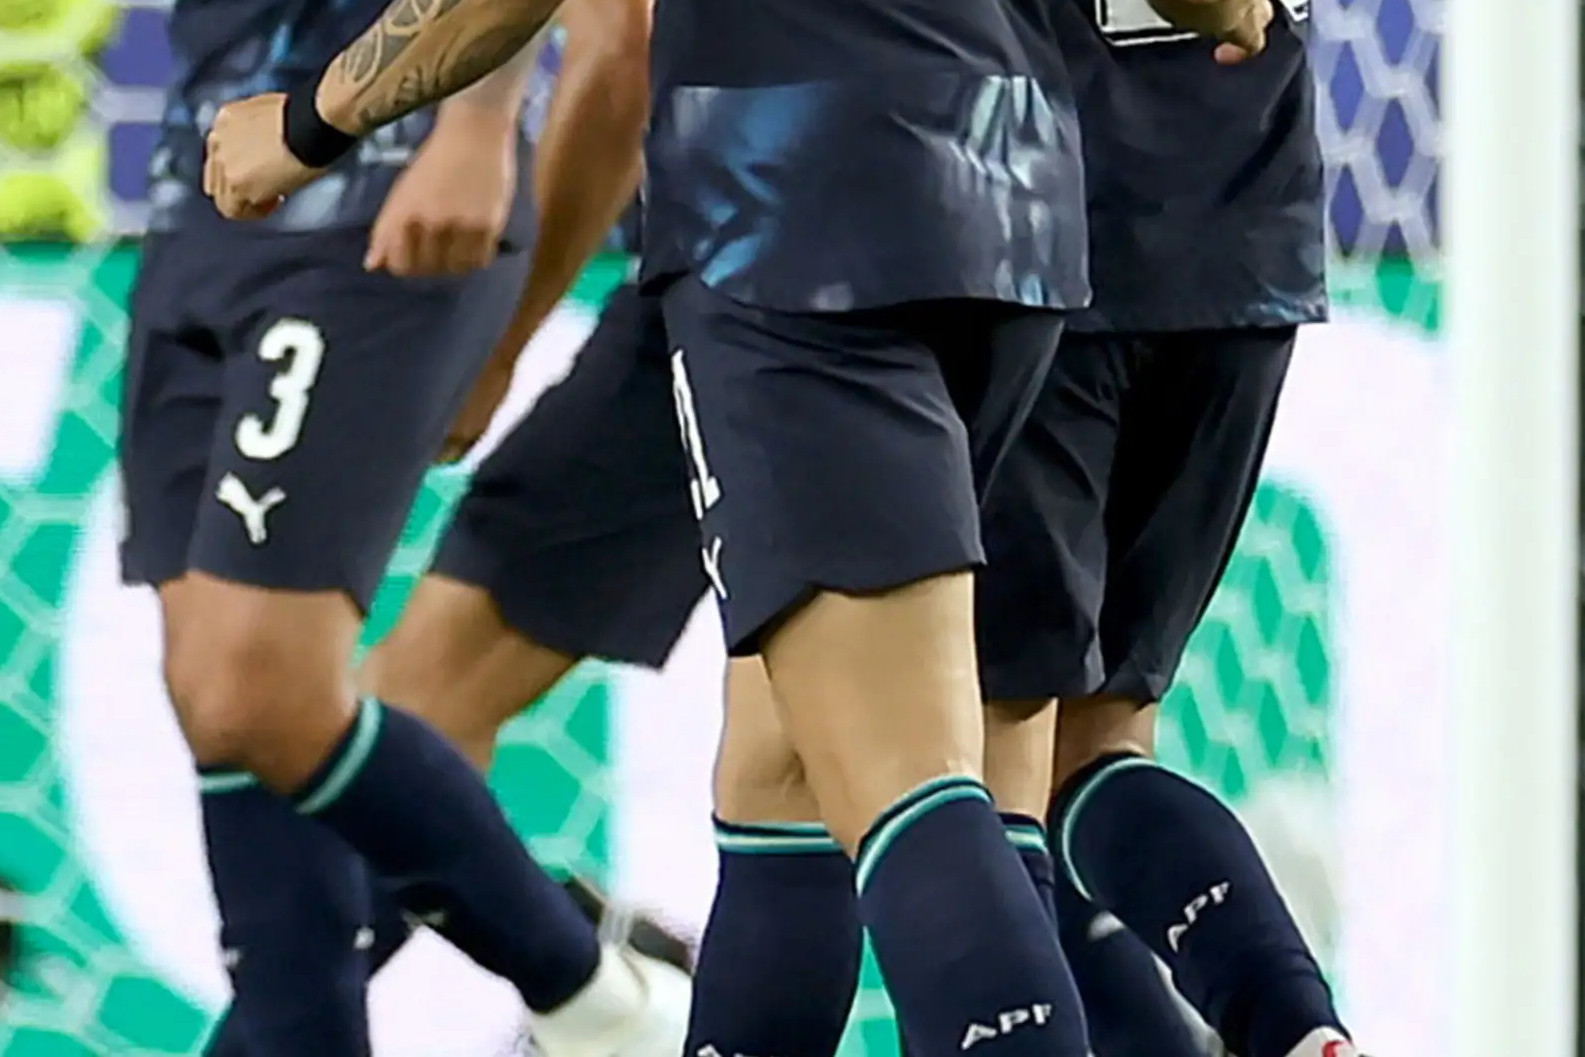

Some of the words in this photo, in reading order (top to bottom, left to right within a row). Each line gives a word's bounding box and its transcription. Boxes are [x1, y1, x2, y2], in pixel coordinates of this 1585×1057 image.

[234, 317, 329, 461] 3
[1166, 879, 1234, 955] APF
[960, 1003, 1053, 1051] APF
